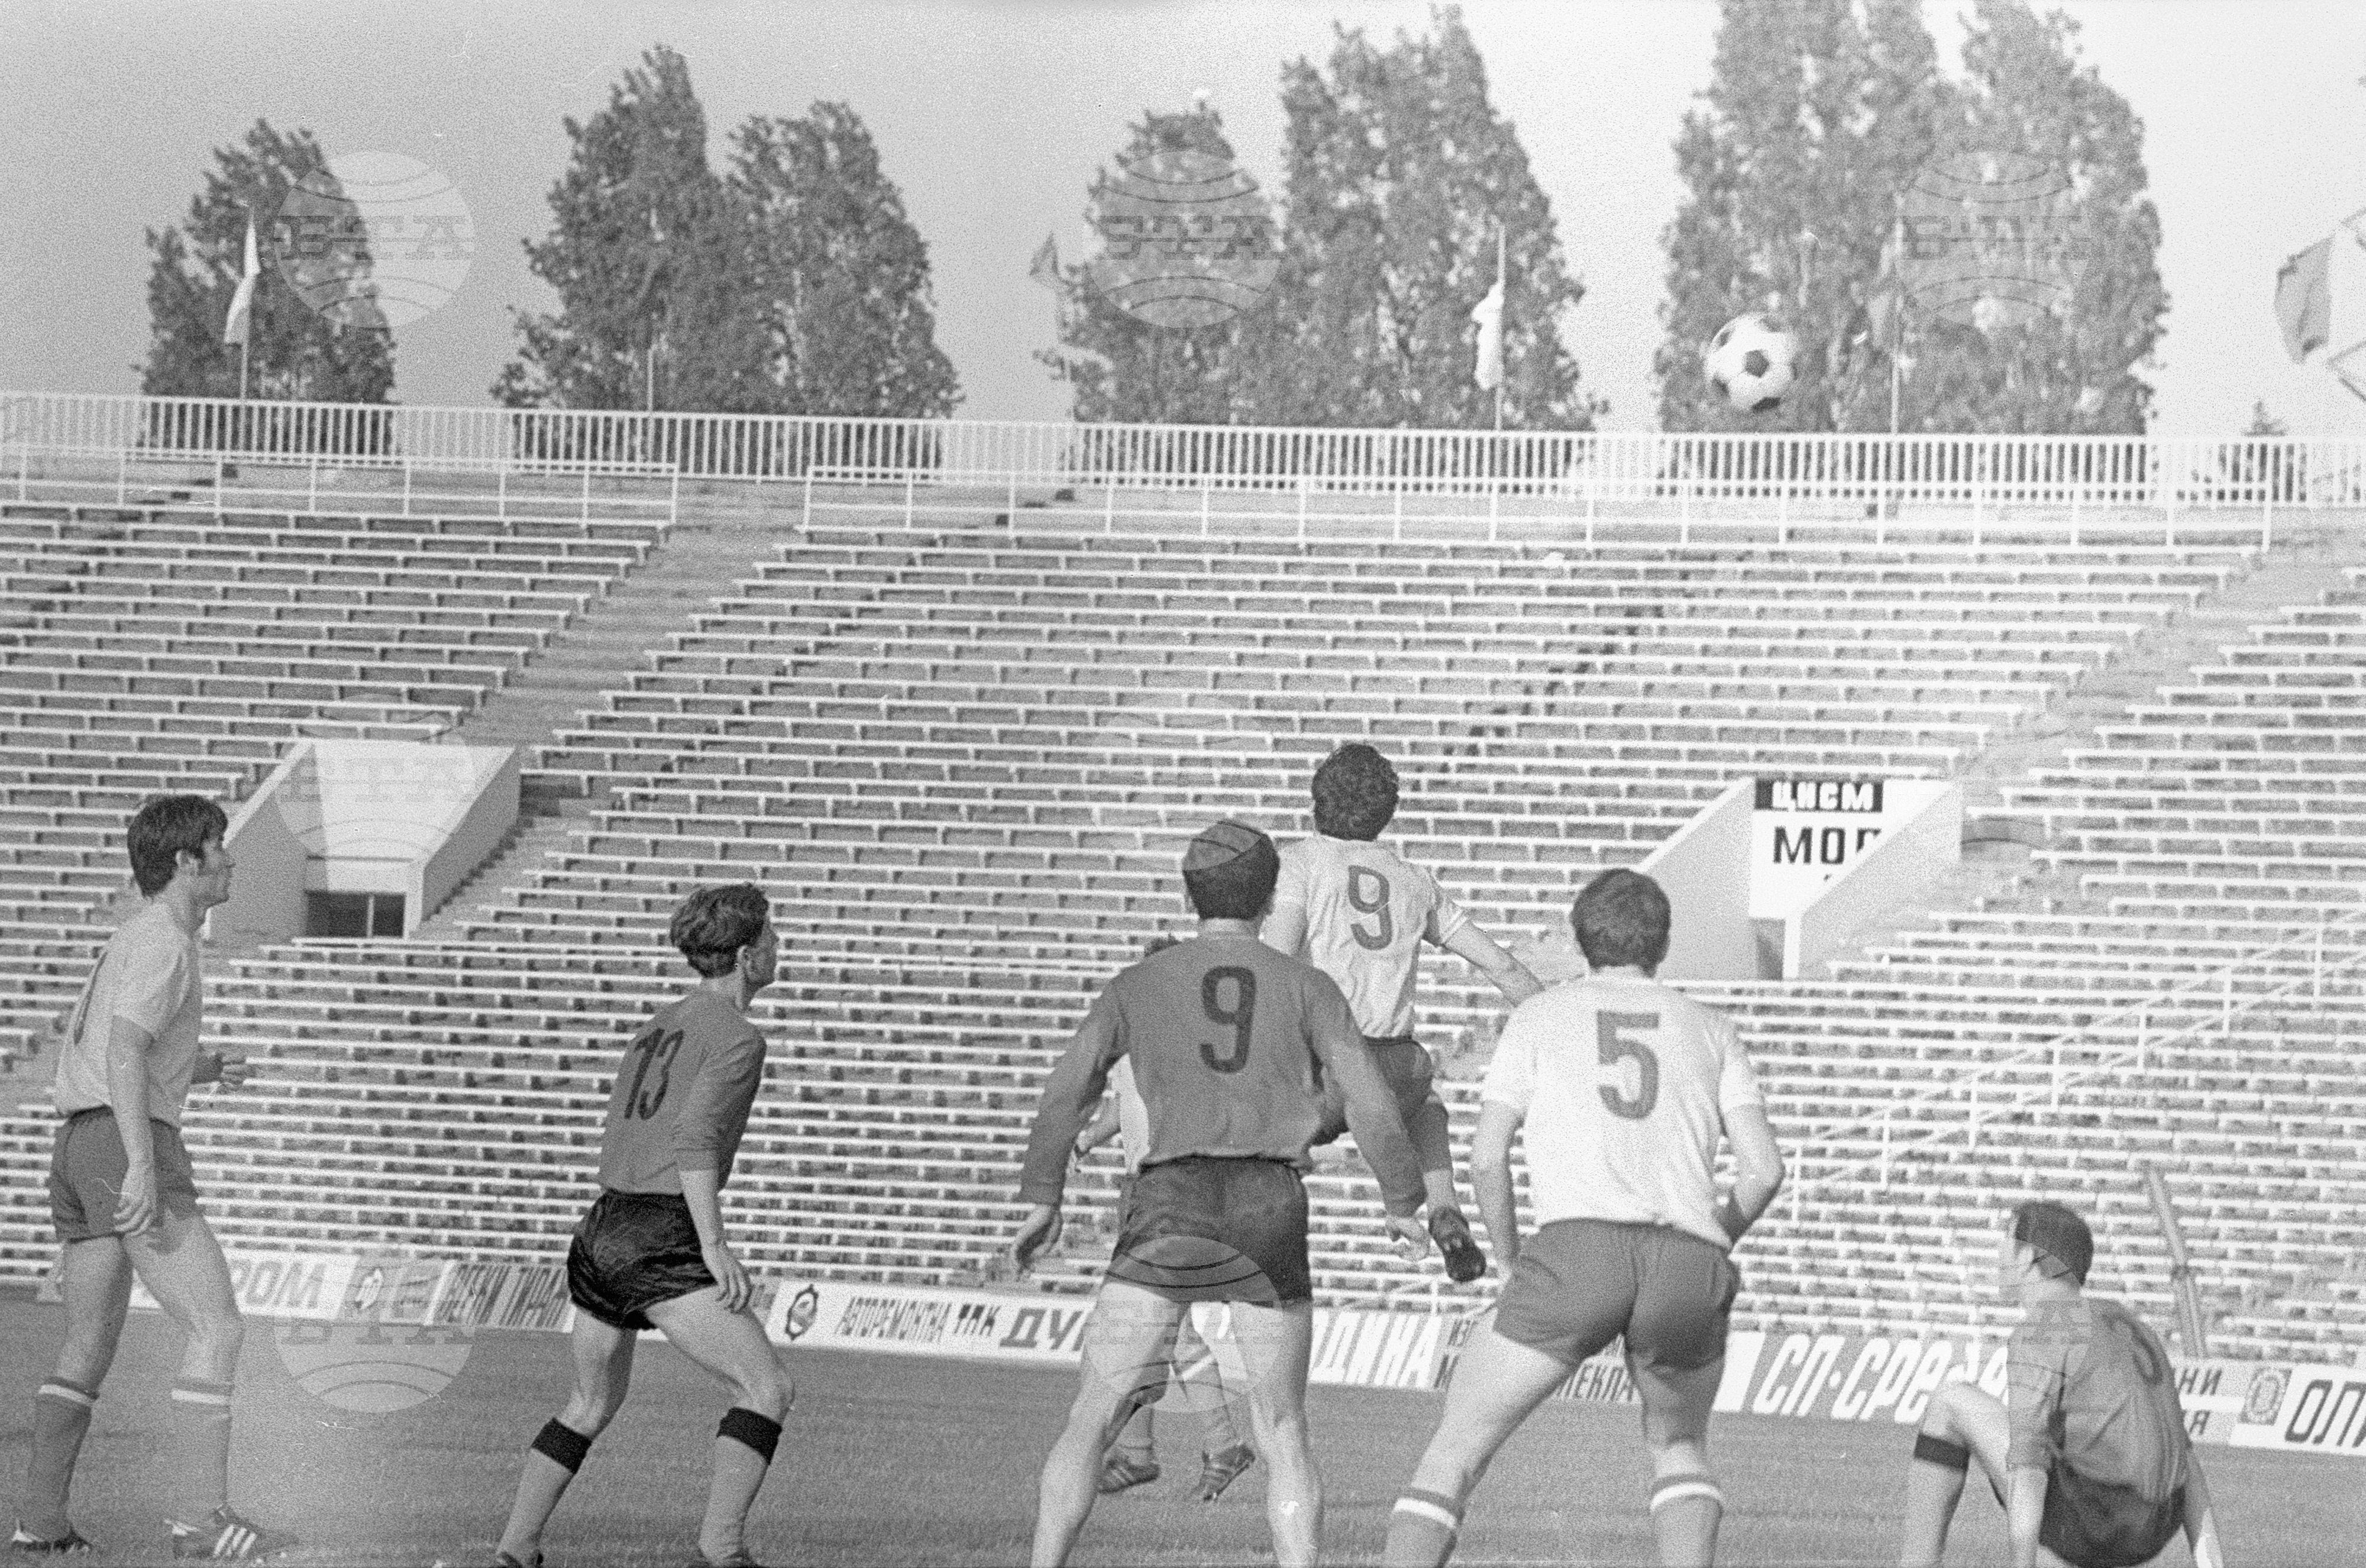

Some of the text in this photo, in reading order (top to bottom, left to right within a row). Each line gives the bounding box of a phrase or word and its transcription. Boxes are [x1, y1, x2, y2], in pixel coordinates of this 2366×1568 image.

[1348, 865, 1392, 950] 9
[1200, 965, 1256, 1074] 9
[1596, 1010, 1659, 1120] 5
[624, 1027, 684, 1120] 13
